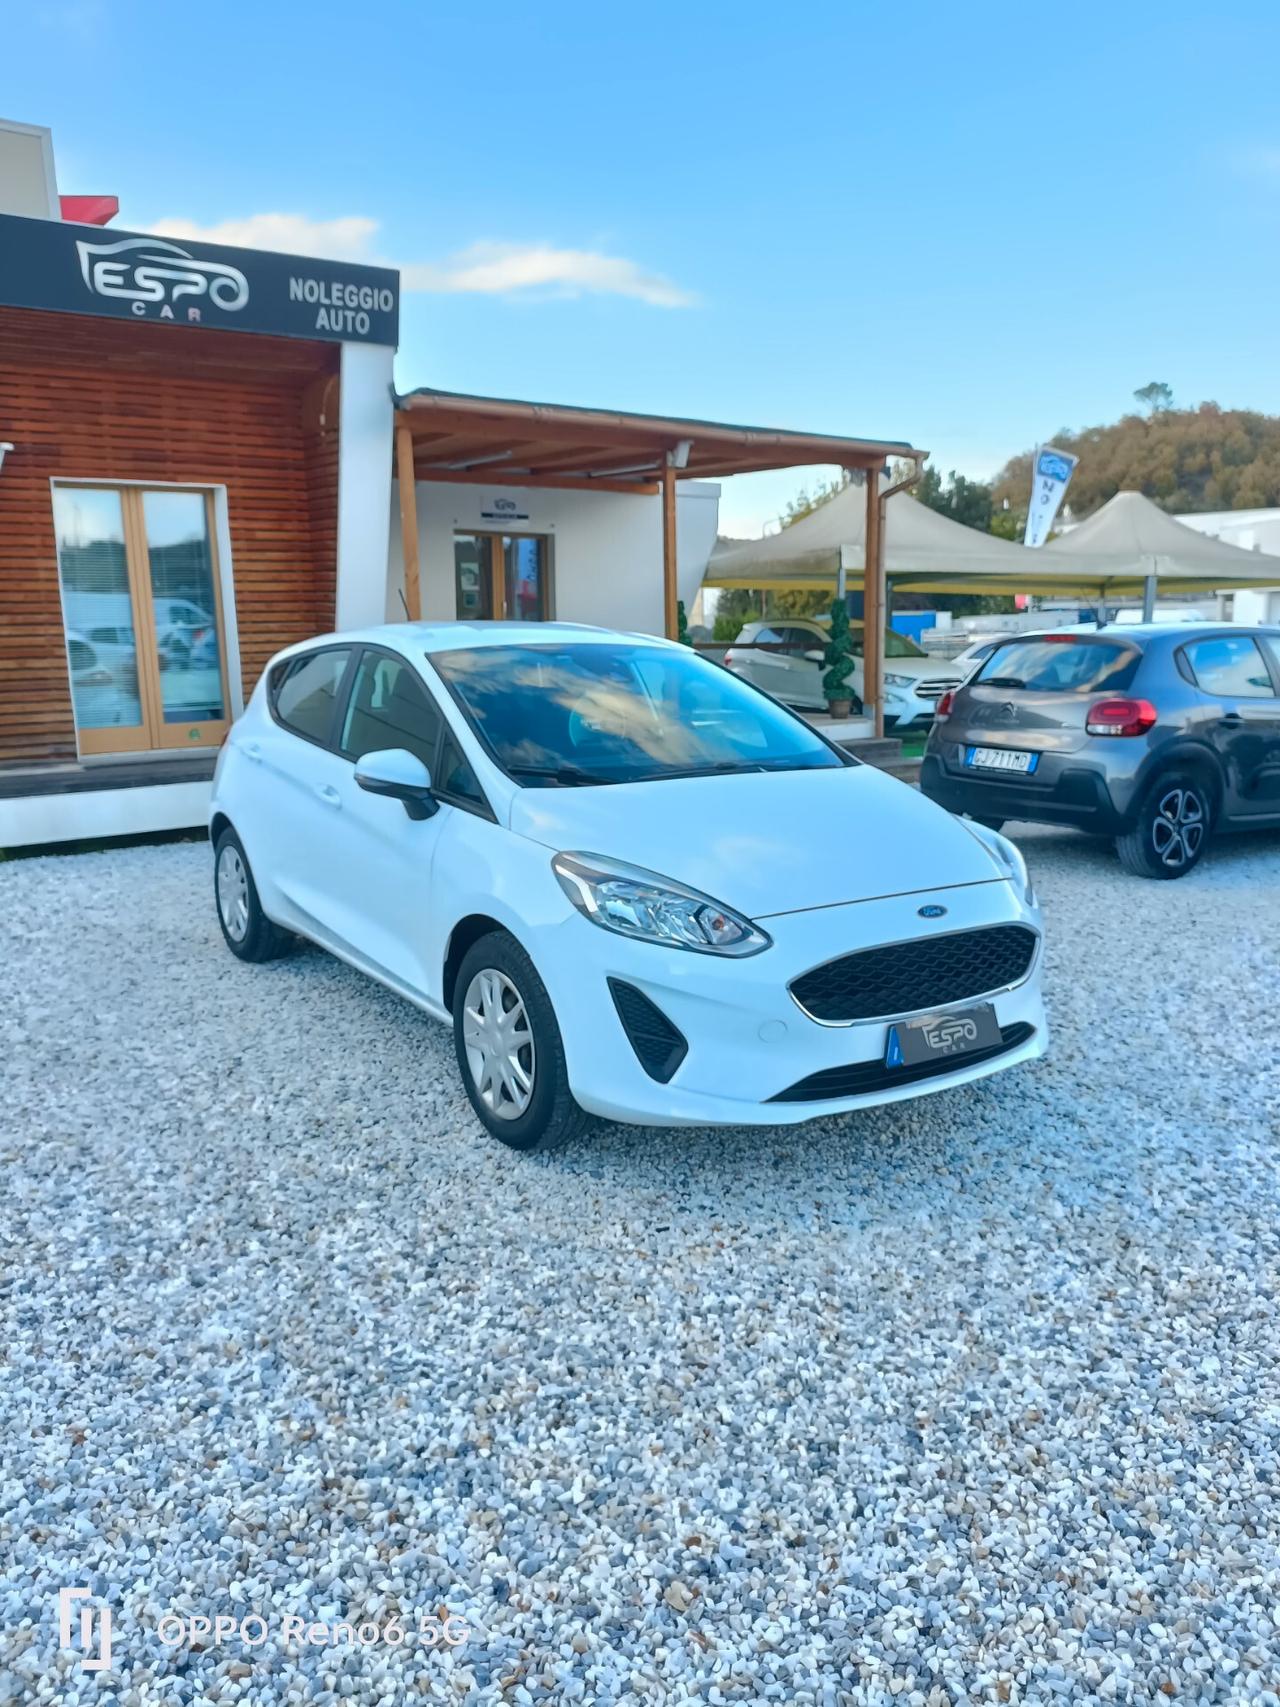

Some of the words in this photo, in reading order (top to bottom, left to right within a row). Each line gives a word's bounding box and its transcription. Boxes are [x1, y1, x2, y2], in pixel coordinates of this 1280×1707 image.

[91, 253, 250, 312] ESPO
[289, 276, 394, 313] NOLEGGIO
[131, 300, 201, 322] CAR
[315, 308, 371, 335] AUTO
[928, 1018, 977, 1049] ESPO
